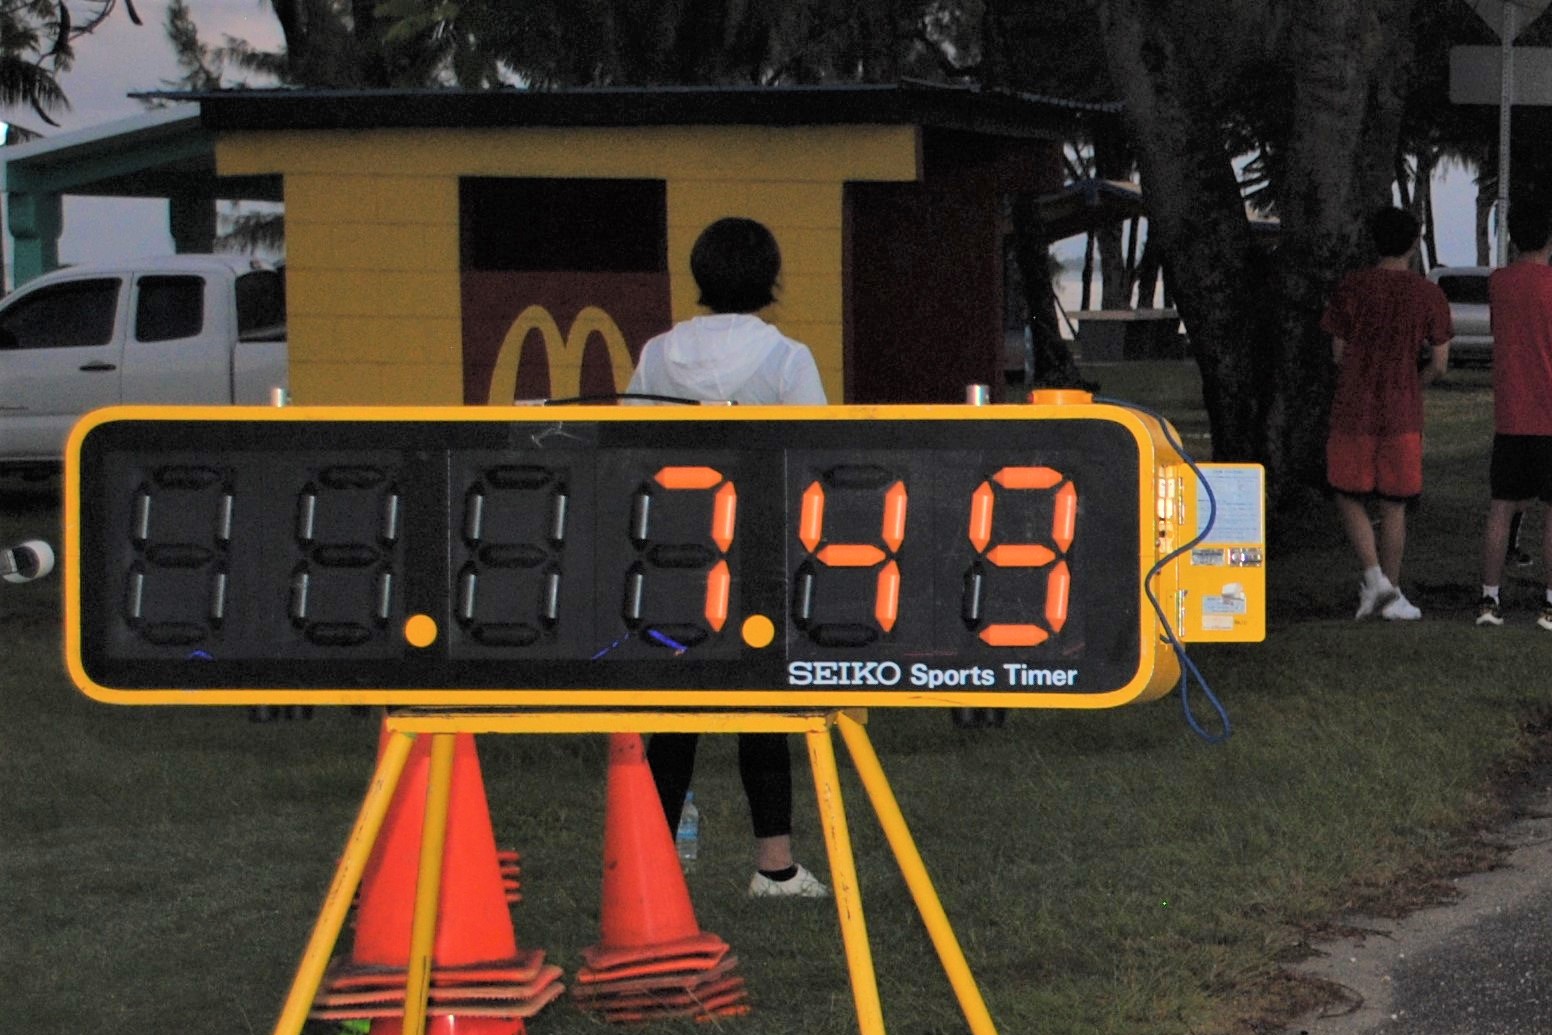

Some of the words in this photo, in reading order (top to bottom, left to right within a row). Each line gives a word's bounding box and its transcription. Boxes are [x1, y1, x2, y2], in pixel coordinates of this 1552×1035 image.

[788, 661, 901, 686] SEIKO
[910, 663, 995, 689] Sports
[1003, 663, 1078, 686] Timer
